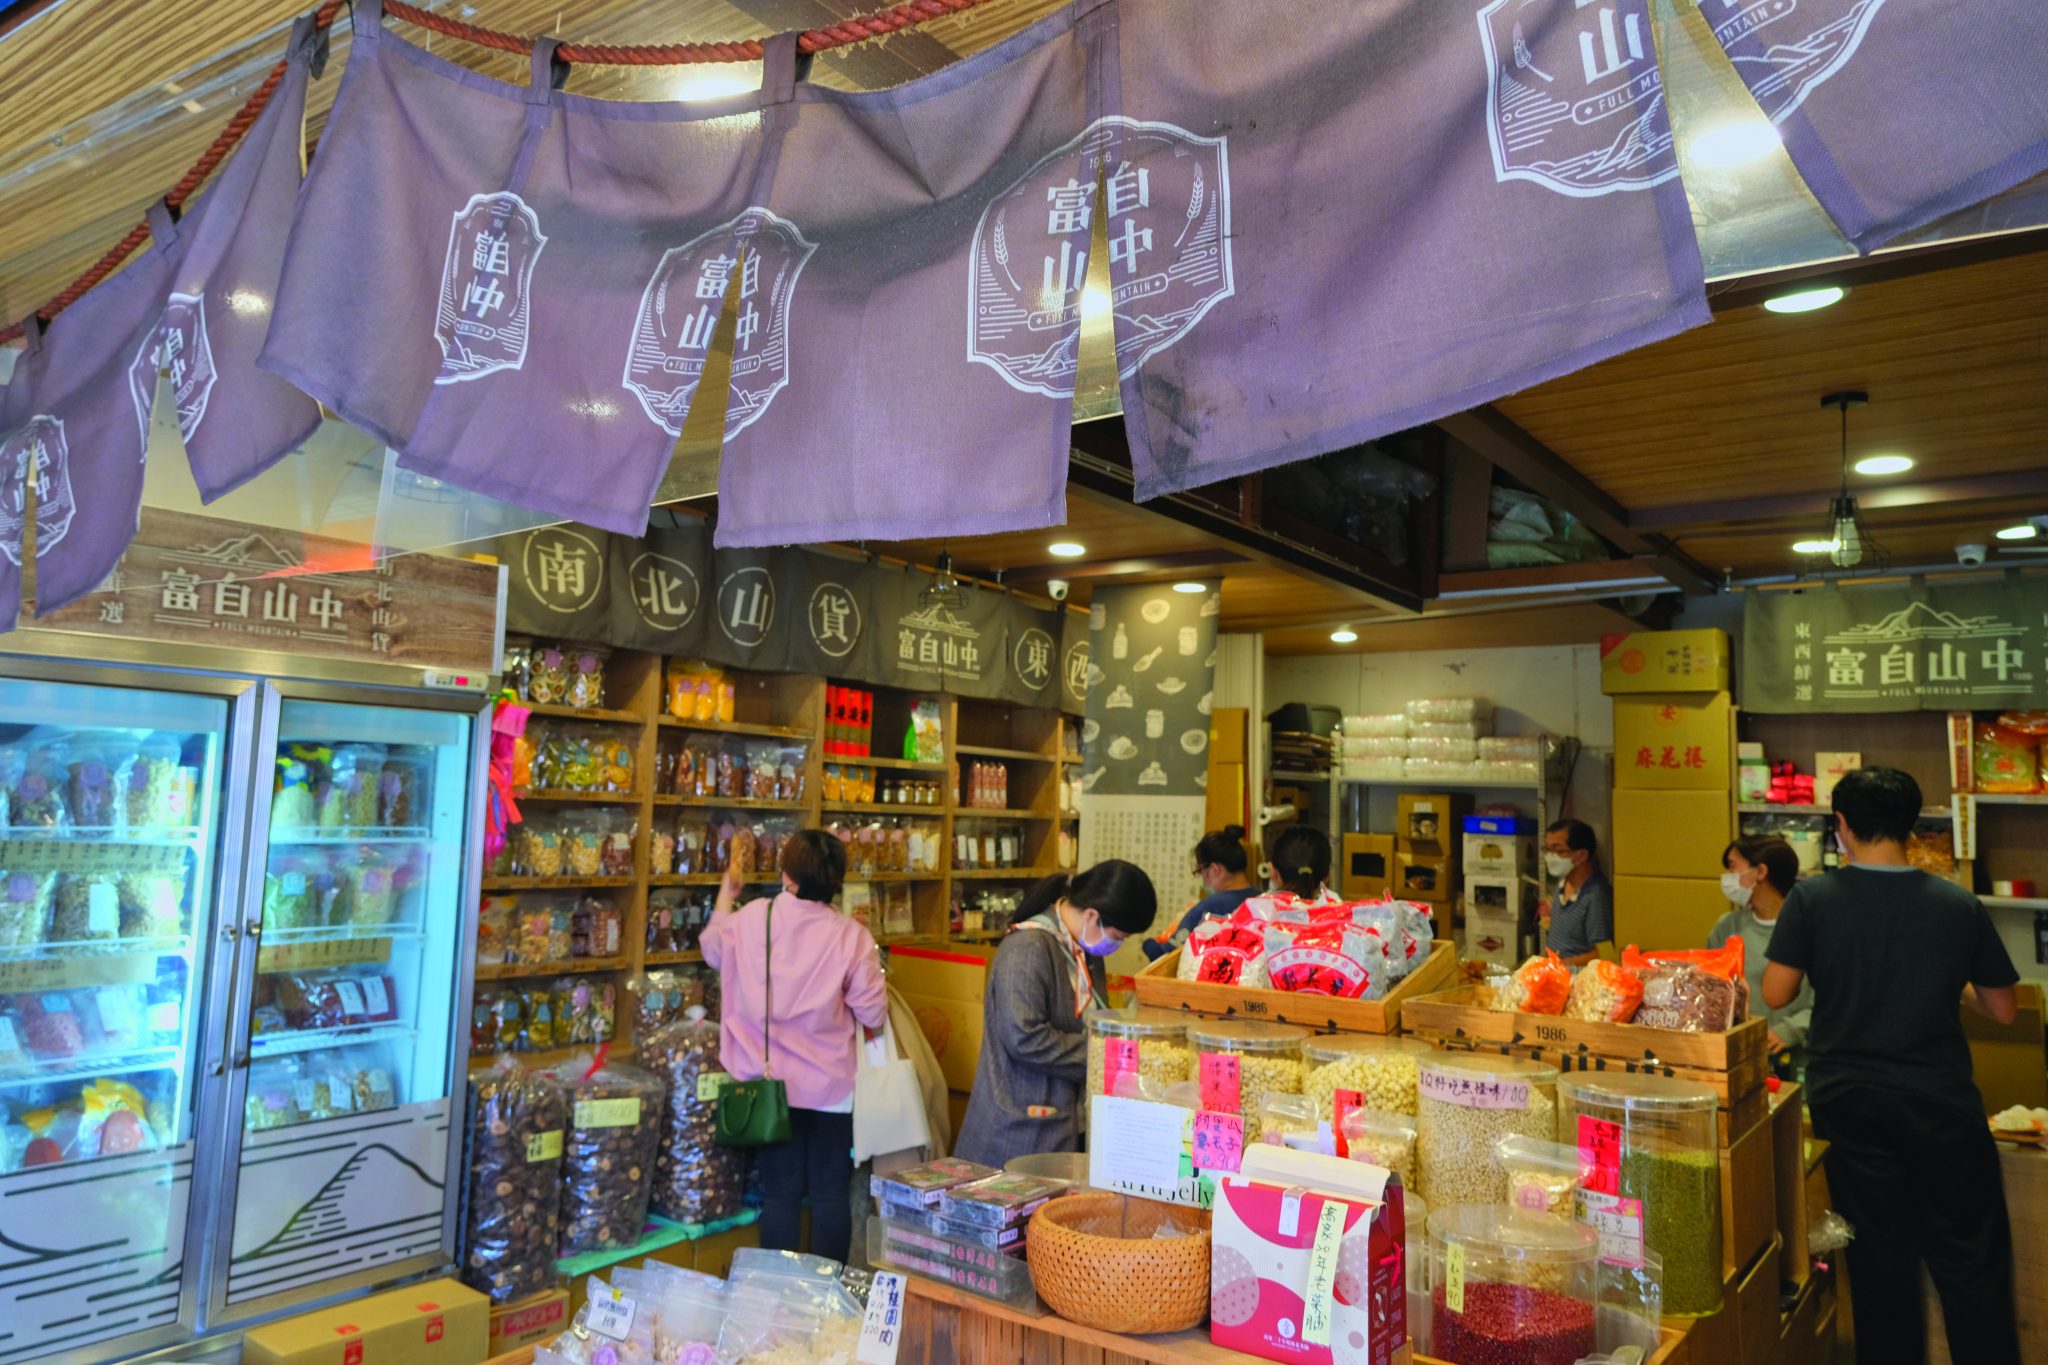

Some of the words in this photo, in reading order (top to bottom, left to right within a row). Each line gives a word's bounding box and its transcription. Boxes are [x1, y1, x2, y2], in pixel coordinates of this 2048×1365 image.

[1599, 86, 1634, 112] FULL
[675, 359, 692, 372] FULL
[536, 542, 587, 597] 南
[640, 566, 688, 615] 北
[161, 566, 345, 630] 富自山中
[730, 582, 769, 632] 山
[818, 594, 850, 643] 貨
[898, 628, 978, 671] 富自山中
[1023, 638, 1050, 678] 東
[1826, 638, 2024, 686] 富自山中
[1889, 689, 1912, 698] FULL
[1914, 686, 1962, 696] MOUNTAIN
[1243, 999, 1268, 1014] 1986
[1535, 1024, 1567, 1041] 1986
